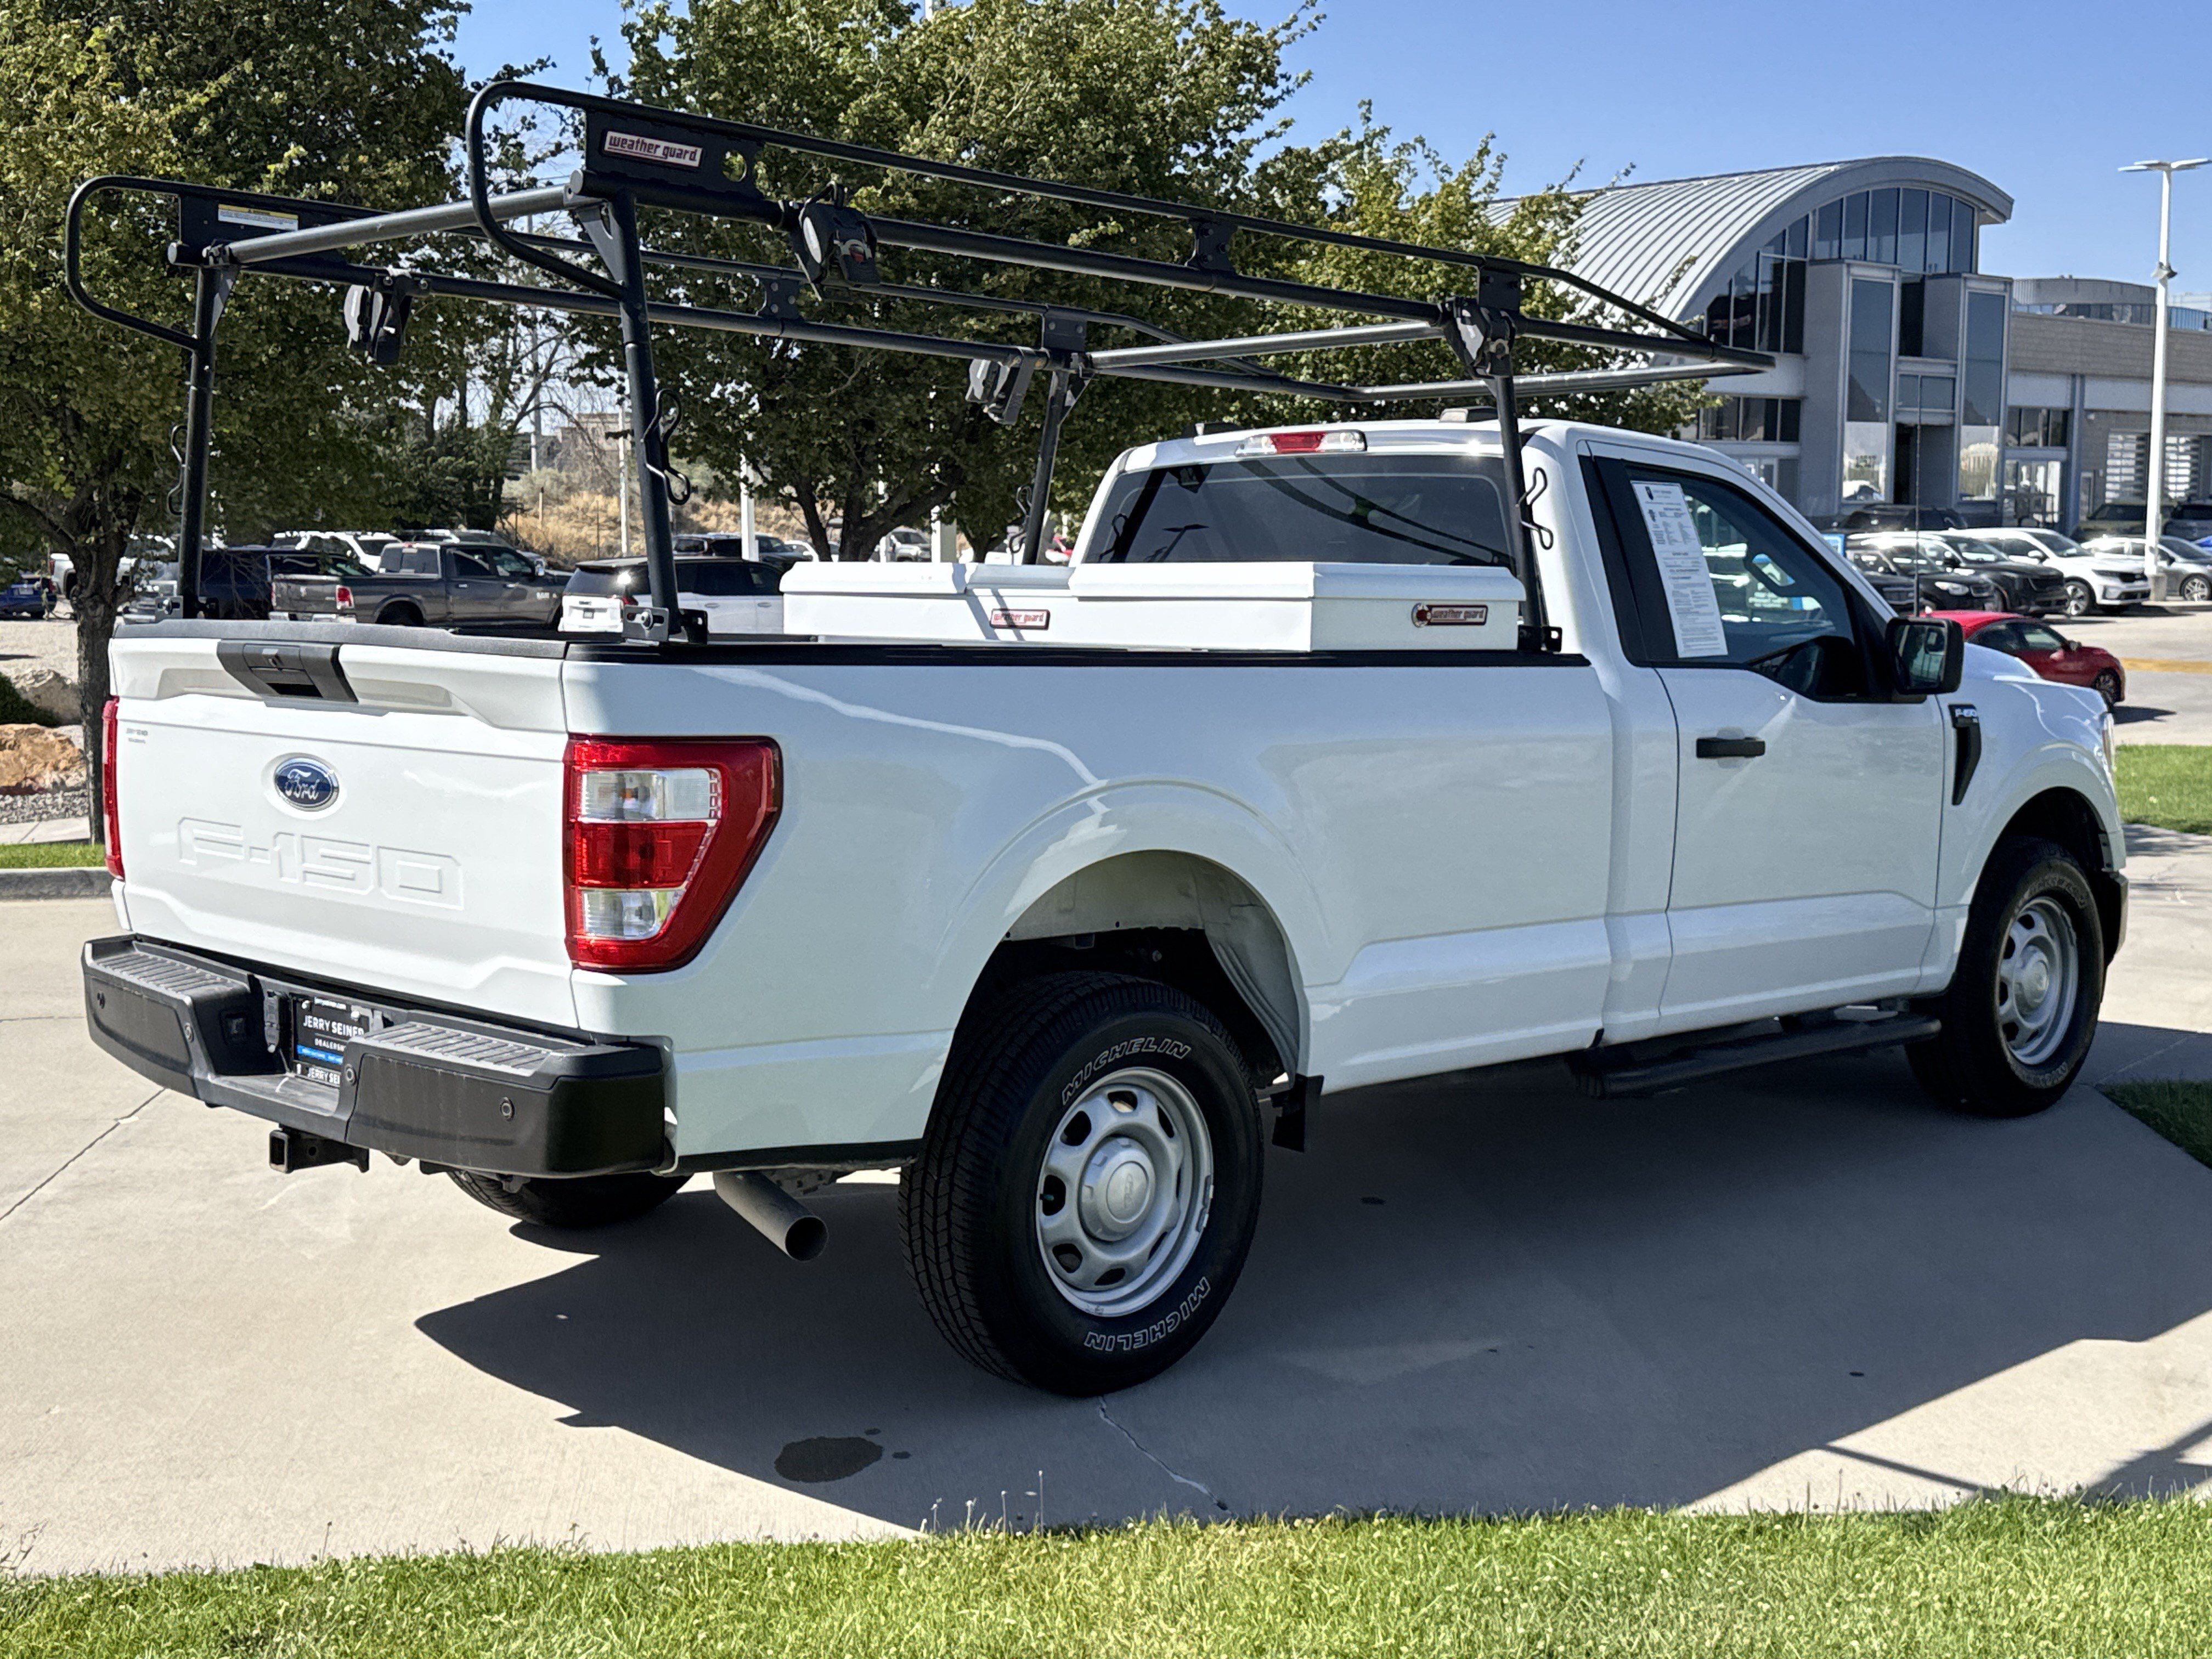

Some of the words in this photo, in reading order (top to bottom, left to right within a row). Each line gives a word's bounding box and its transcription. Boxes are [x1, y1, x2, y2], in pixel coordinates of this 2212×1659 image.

[608, 135, 661, 155] weather
[662, 145, 697, 161] guard
[284, 768, 320, 801] Ford
[178, 816, 465, 911] F-150
[303, 1015, 330, 1031] JERRY
[307, 1067, 329, 1082] JERRY
[1062, 1037, 1192, 1105] MICHELIN
[1084, 1276, 1211, 1352] MICHELIN
